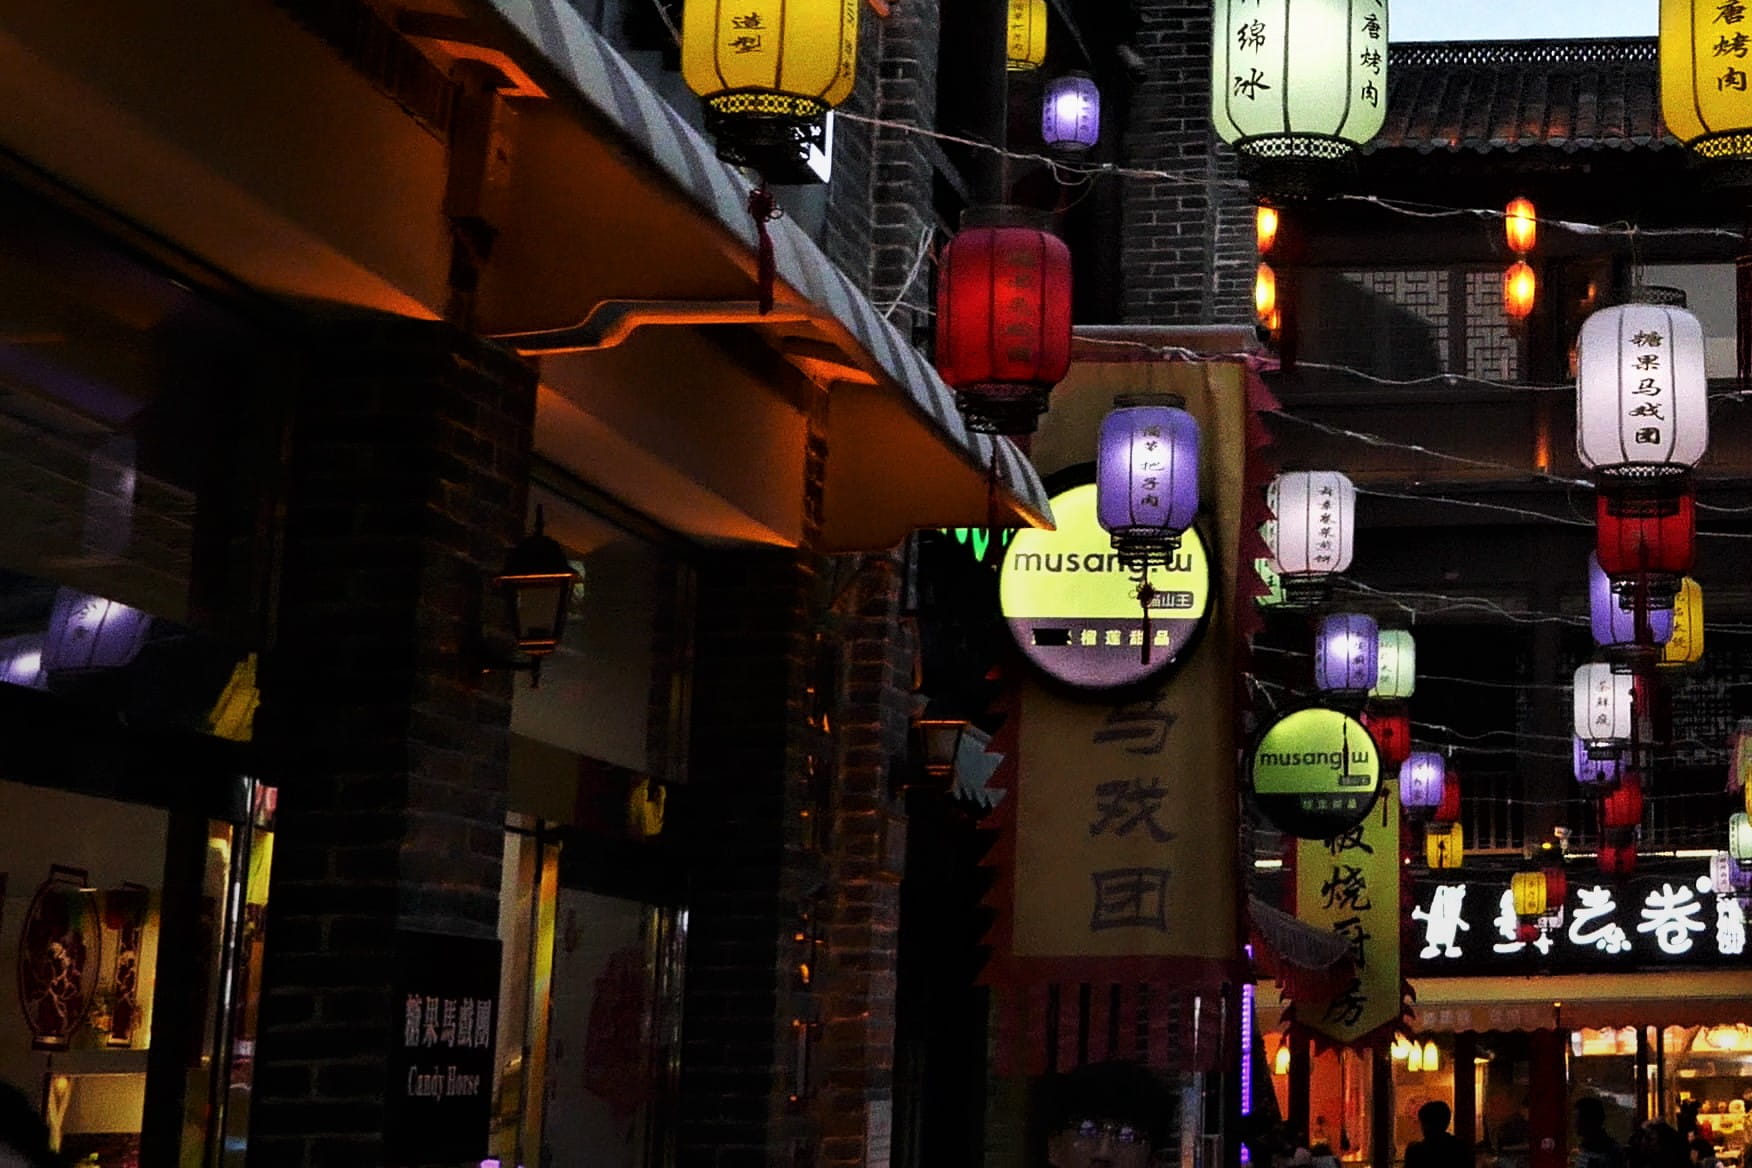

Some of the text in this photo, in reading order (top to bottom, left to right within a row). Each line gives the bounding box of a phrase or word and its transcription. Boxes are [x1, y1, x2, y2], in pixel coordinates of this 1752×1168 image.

[1628, 329, 1665, 445] 糖果马戏团
[407, 1065, 481, 1101] Candy Horse
